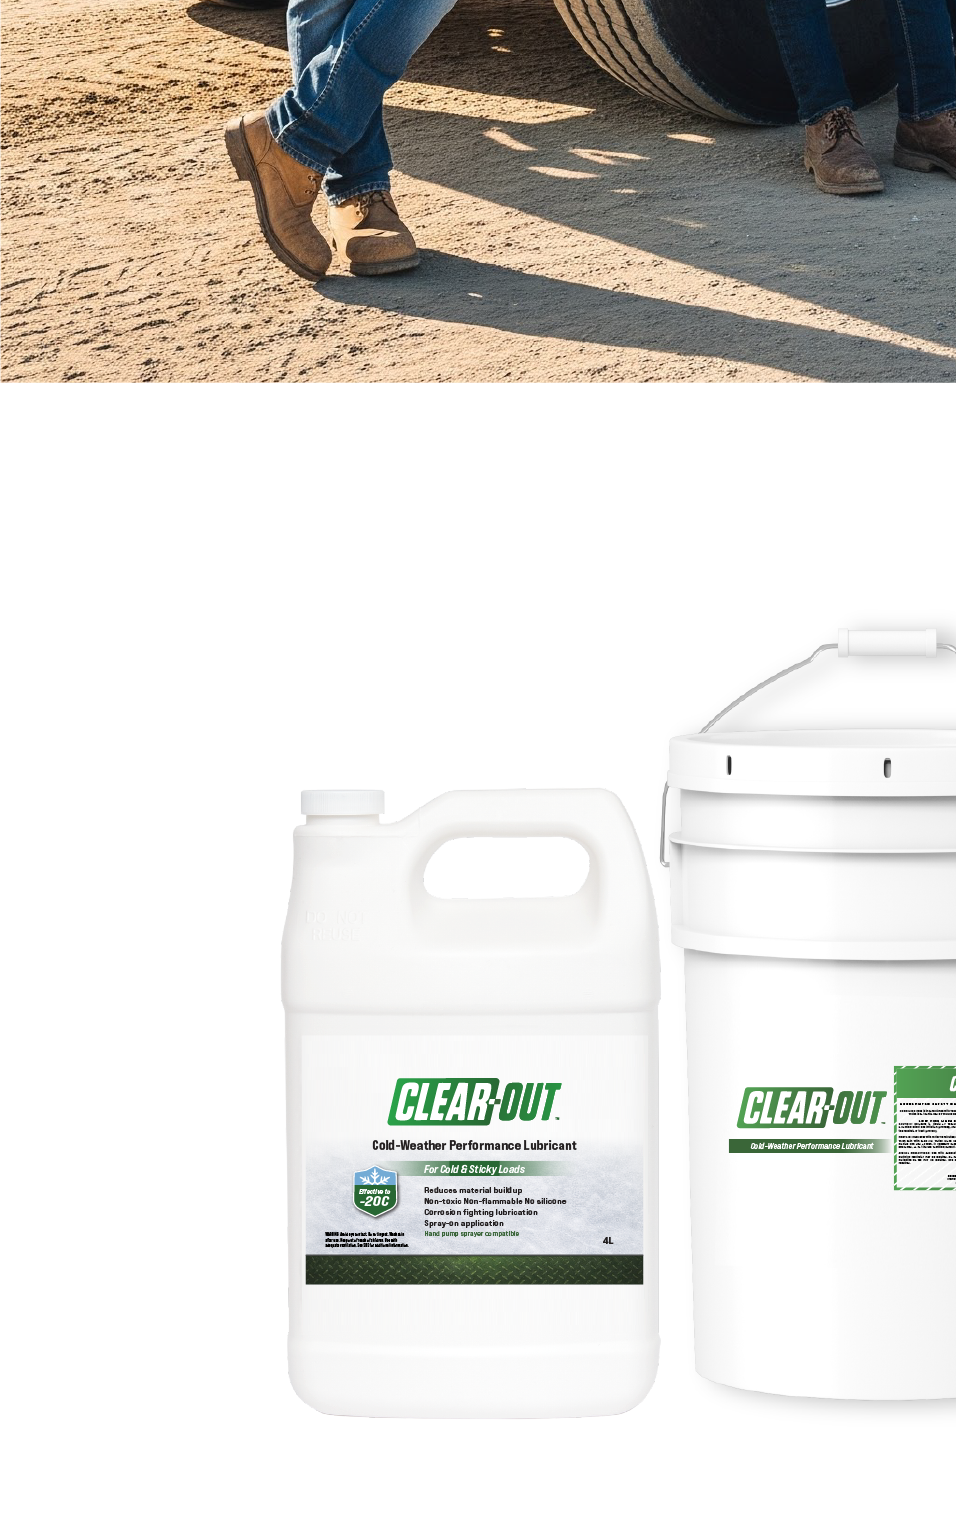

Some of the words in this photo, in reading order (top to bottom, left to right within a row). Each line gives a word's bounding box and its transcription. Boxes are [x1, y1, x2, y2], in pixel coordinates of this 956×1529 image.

[305, 910, 326, 925] DO
[336, 910, 367, 925] NOT
[311, 927, 361, 942] REUSE
[394, 1081, 562, 1122] CLEAR-OUT
[742, 1089, 888, 1125] CLEAR-OUT
[372, 1139, 447, 1151] Cold-Weather
[449, 1139, 522, 1151] Performance
[523, 1139, 578, 1151] Lubricant
[750, 1141, 796, 1150] Cold-Weather
[796, 1141, 841, 1150] Performance
[841, 1141, 875, 1150] Lubricant
[423, 1164, 439, 1174] For
[440, 1164, 460, 1174] Cold
[461, 1164, 468, 1174] &
[469, 1164, 498, 1176] Sticky
[498, 1164, 526, 1174] Loads
[424, 1186, 458, 1194] Reduces
[459, 1186, 492, 1194] material
[493, 1186, 523, 1196] buildup
[359, 1195, 390, 1207] -20C
[424, 1197, 462, 1205] Non-toxic
[463, 1197, 523, 1205] Non-flammable
[524, 1197, 535, 1205] No
[536, 1197, 567, 1205] silicone
[424, 1208, 462, 1216] Corrosion
[463, 1208, 495, 1218] fighting
[495, 1208, 539, 1216] lubrication
[424, 1219, 459, 1229] Spray-on
[460, 1219, 505, 1229] application
[485, 1230, 520, 1238] compatible
[602, 1236, 615, 1245] 4L
